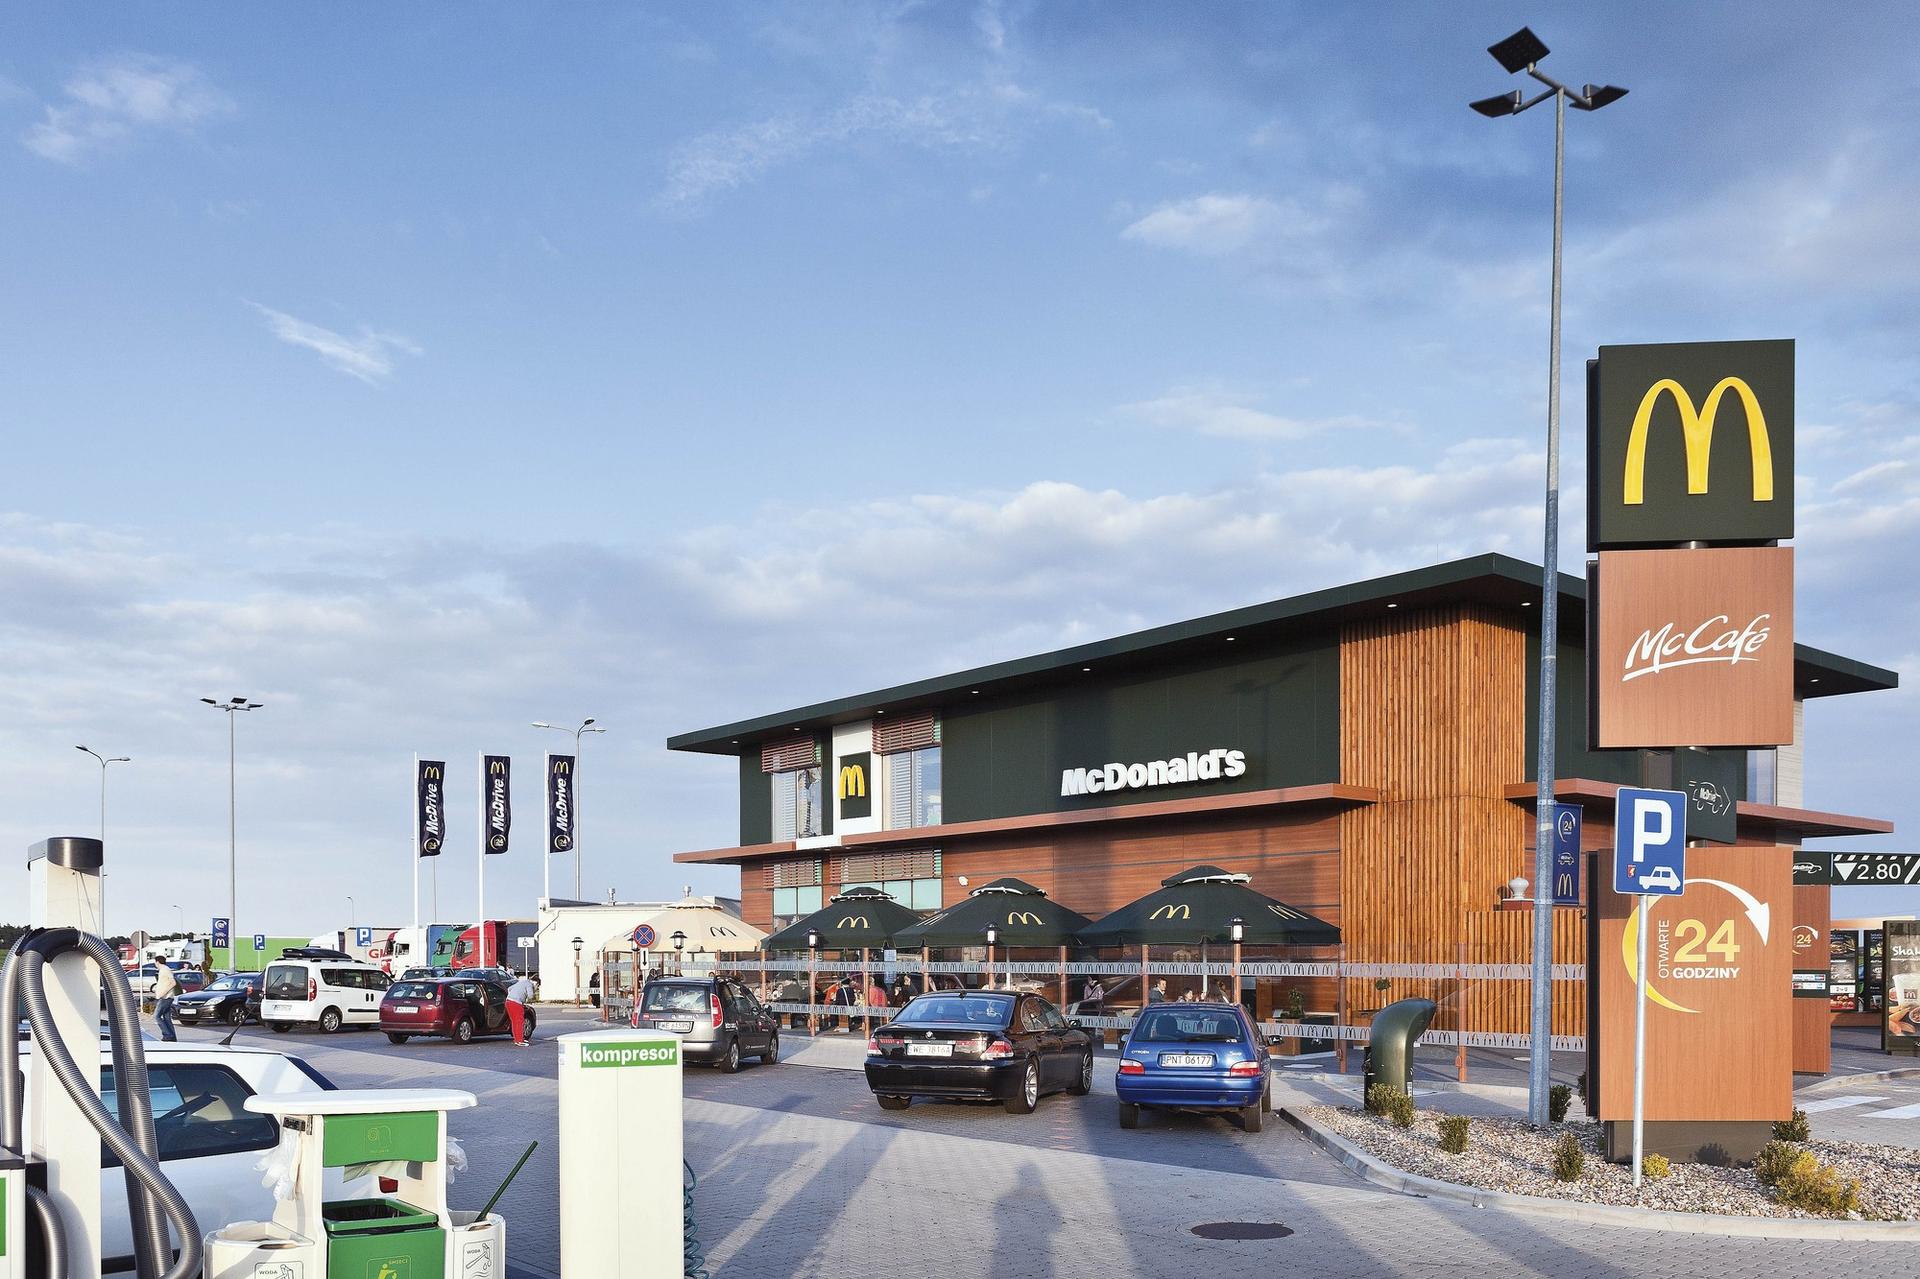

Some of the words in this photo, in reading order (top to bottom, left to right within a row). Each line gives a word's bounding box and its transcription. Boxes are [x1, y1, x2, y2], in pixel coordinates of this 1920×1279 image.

[1624, 614, 1771, 676] McCafé
[1061, 749, 1246, 796] McDonald's
[426, 783, 438, 835] McDrive
[492, 778, 505, 831] McDrive
[556, 777, 569, 831] McDrive
[1633, 799, 1672, 862] P
[1857, 864, 1901, 880] 2.80
[360, 929, 369, 941] P
[1658, 919, 1669, 978] OTWARTE
[1673, 918, 1740, 962] 24
[1796, 934, 1812, 944] 24
[1673, 967, 1739, 979] GODZINY
[582, 1045, 675, 1065] kompresor
[1166, 1055, 1182, 1065] PNT
[1185, 1055, 1212, 1065] 06177
